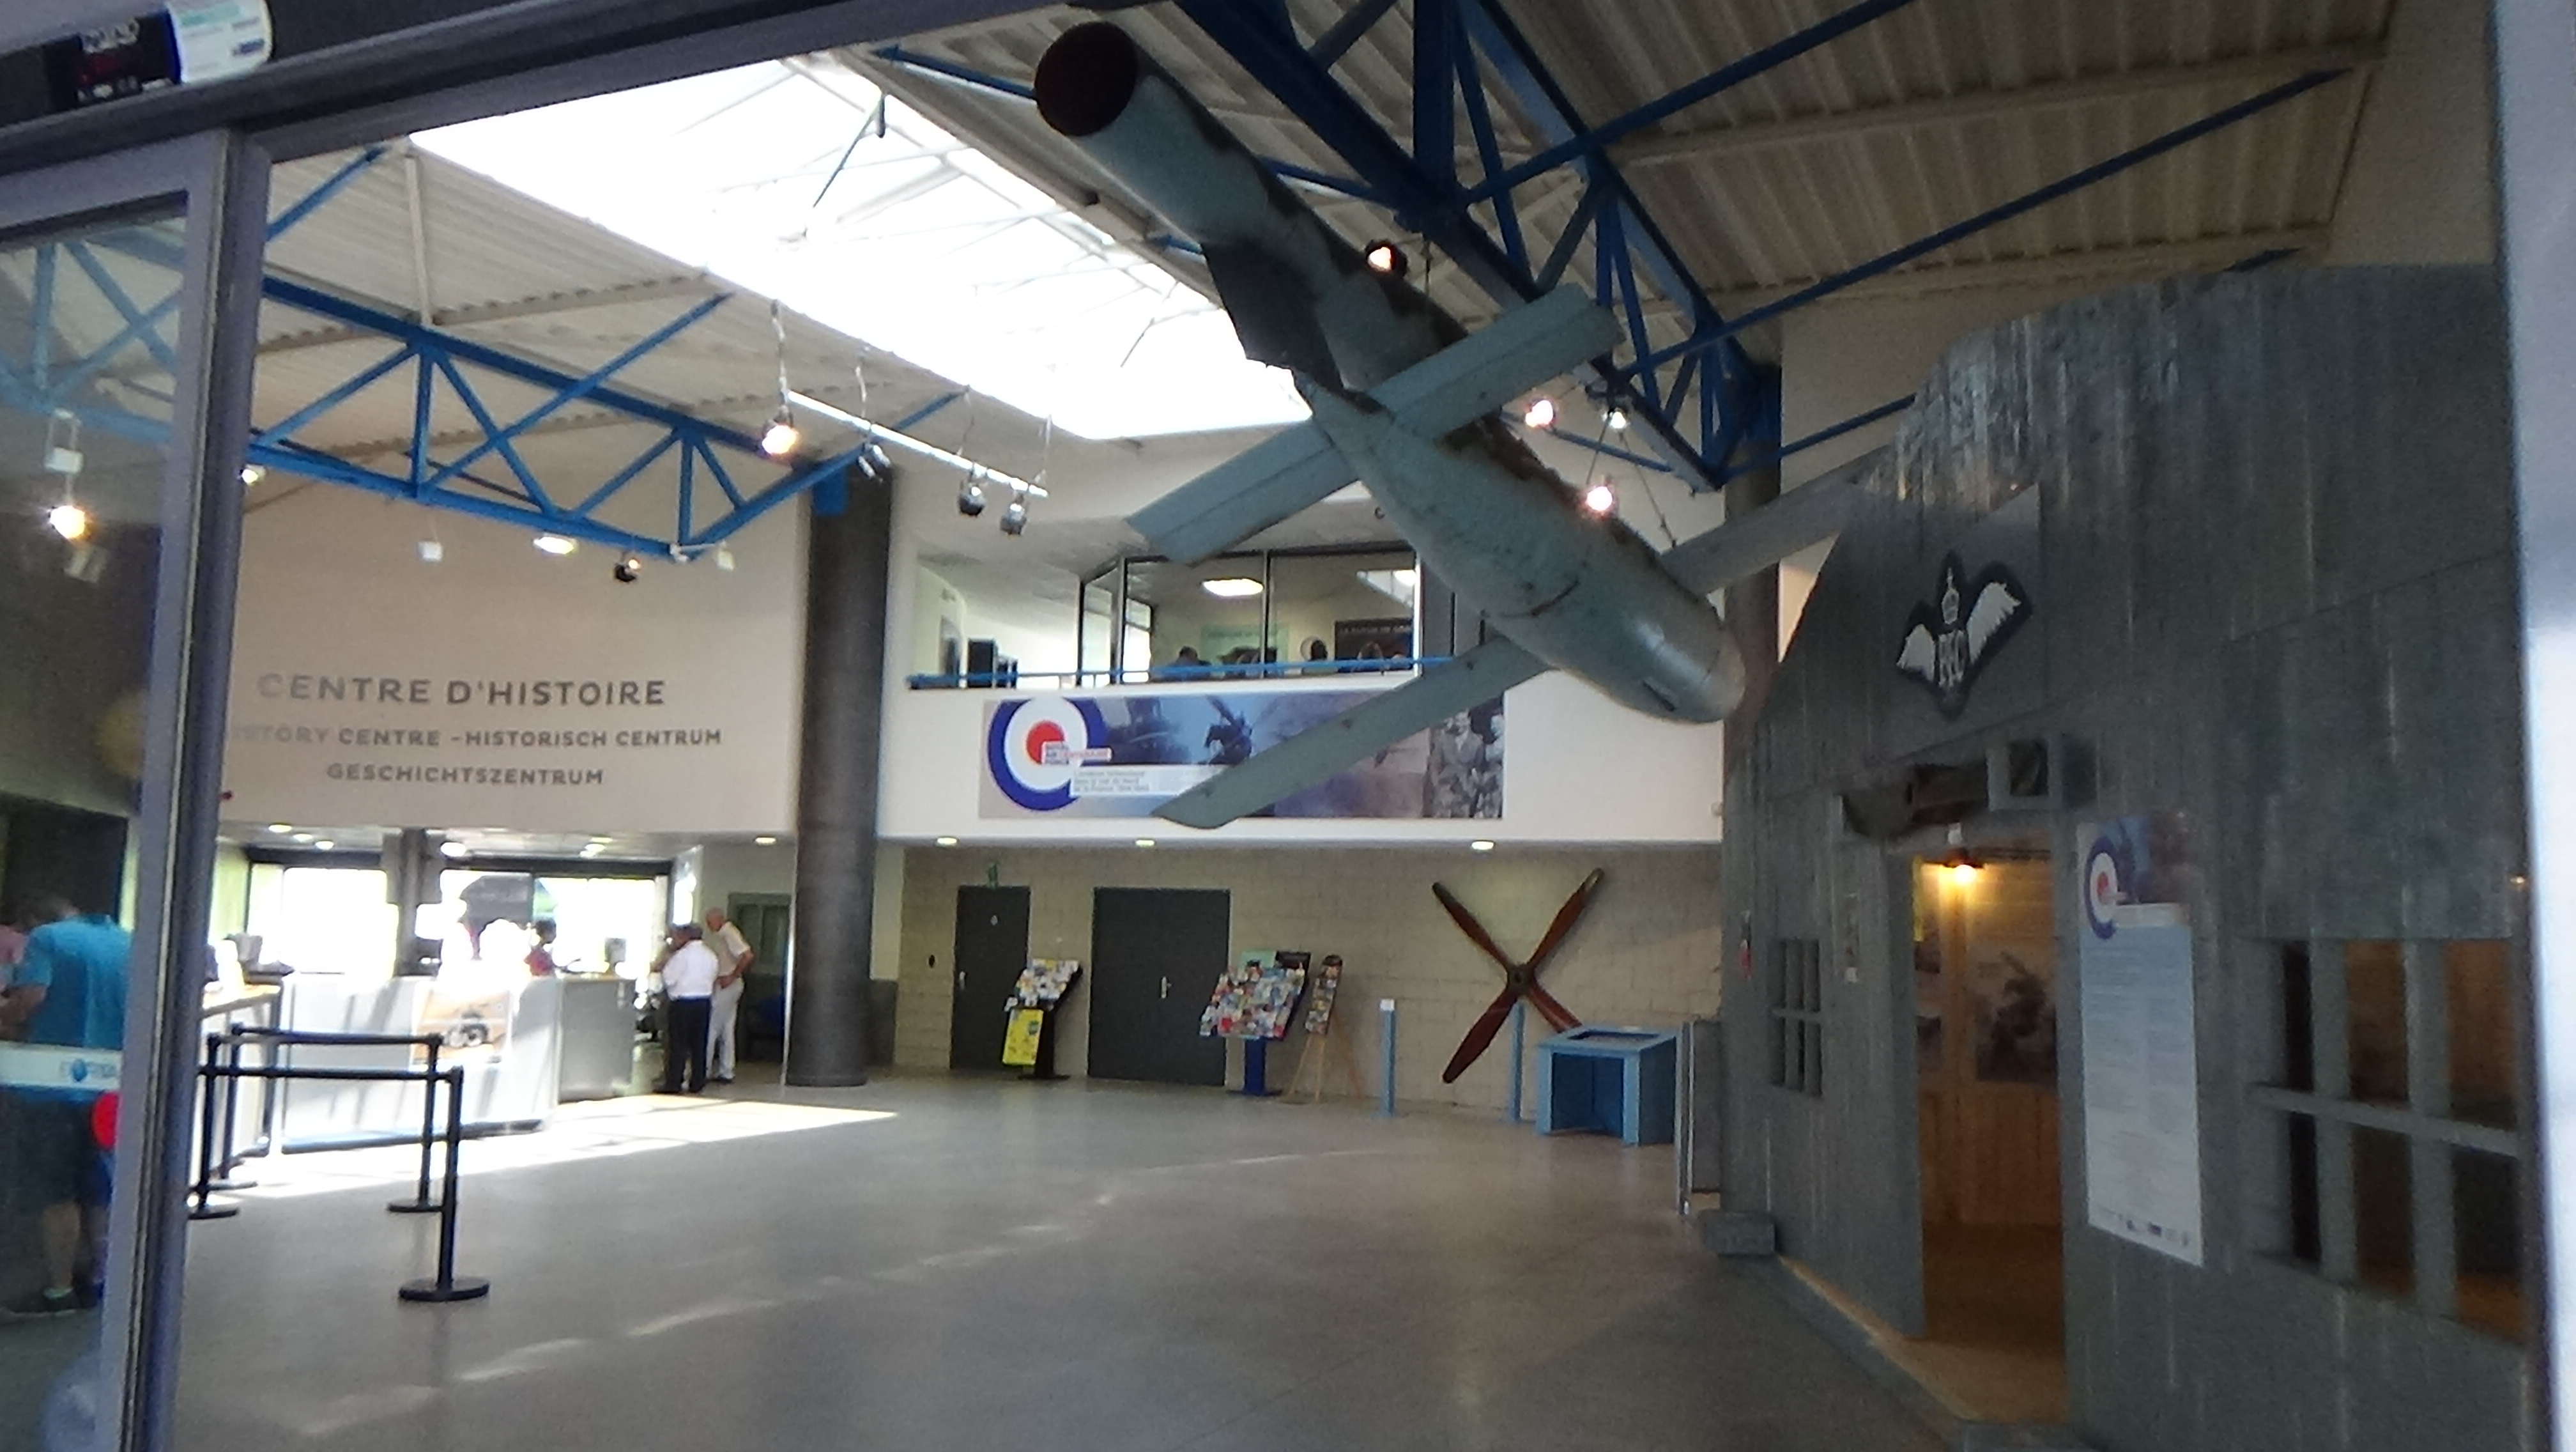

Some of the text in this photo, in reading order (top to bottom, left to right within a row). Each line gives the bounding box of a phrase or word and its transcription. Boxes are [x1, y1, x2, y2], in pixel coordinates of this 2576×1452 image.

[257, 673, 666, 706] CENTRE D'HISTOIRE
[233, 723, 331, 743] STORY
[338, 727, 441, 746] CENTRE
[465, 730, 606, 748] HISTORISCH
[616, 729, 723, 746] CENTRUM
[326, 764, 603, 785] GESCHICHTSZENTRUM
